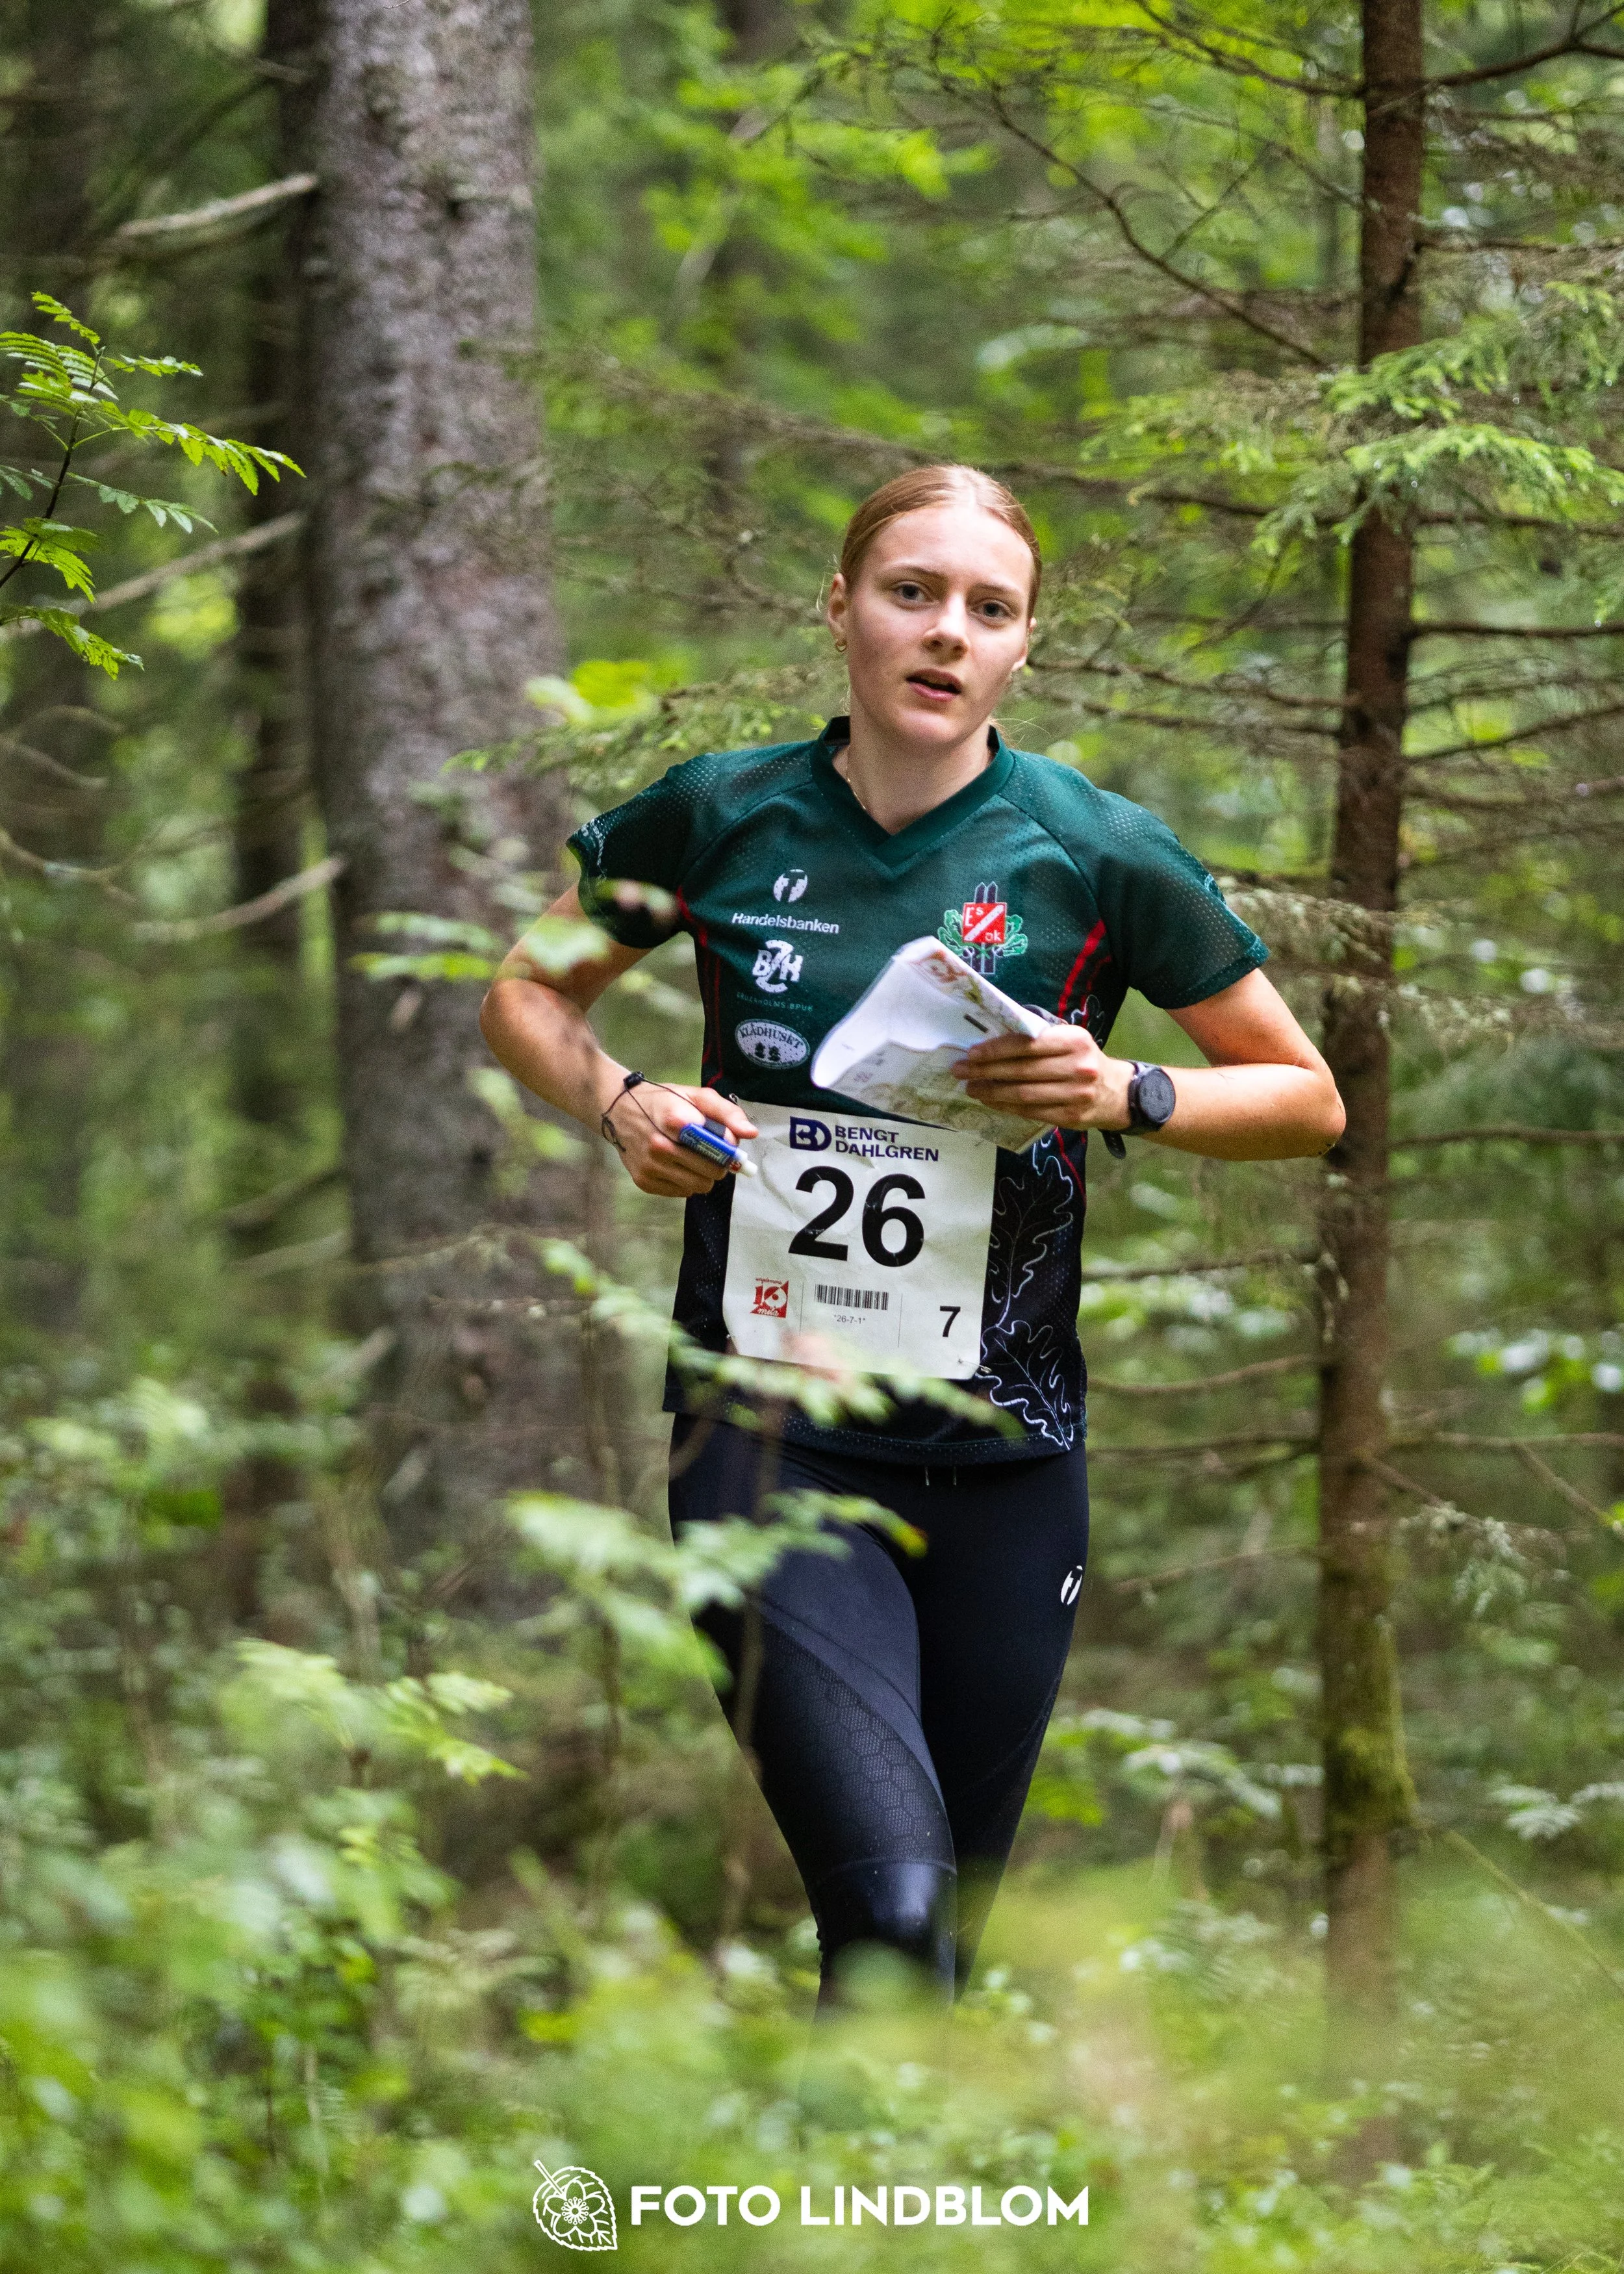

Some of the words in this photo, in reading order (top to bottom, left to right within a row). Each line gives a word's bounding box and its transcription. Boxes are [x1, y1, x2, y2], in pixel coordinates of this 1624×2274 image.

[731, 912, 840, 934] Handelsbanken
[835, 1125, 900, 1143] BENGT
[835, 1140, 939, 1162] DAHLGREN
[788, 1166, 926, 1268] 26
[939, 1305, 961, 1338] 7
